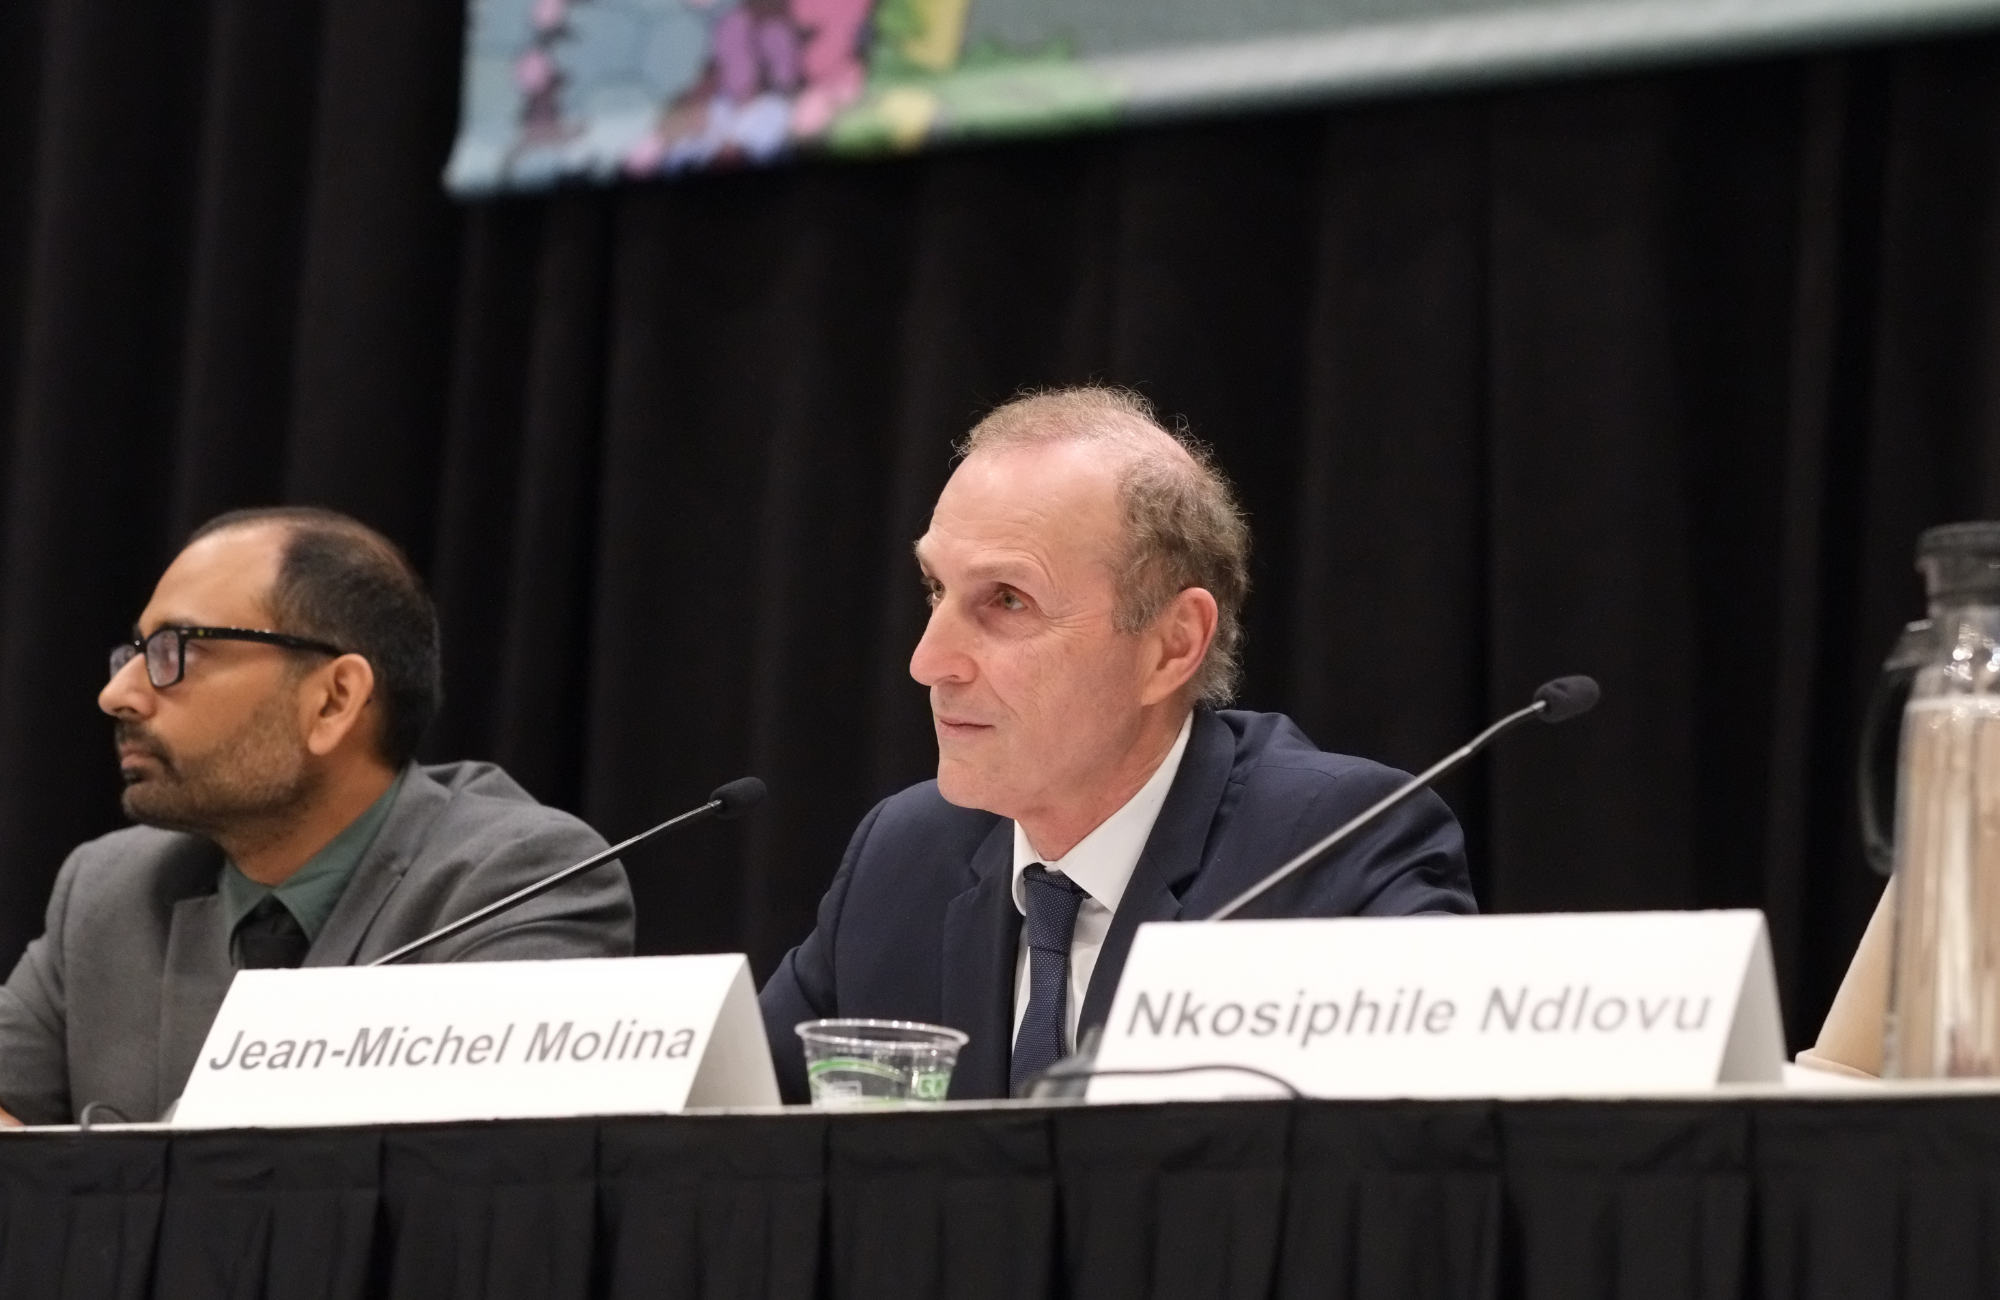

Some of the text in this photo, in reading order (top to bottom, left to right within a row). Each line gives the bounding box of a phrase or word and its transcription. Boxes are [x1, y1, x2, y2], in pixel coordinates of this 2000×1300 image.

[209, 1020, 697, 1071] Jean-Michel Molina
[1125, 985, 1714, 1049] Nkosiphile Ndlovu
